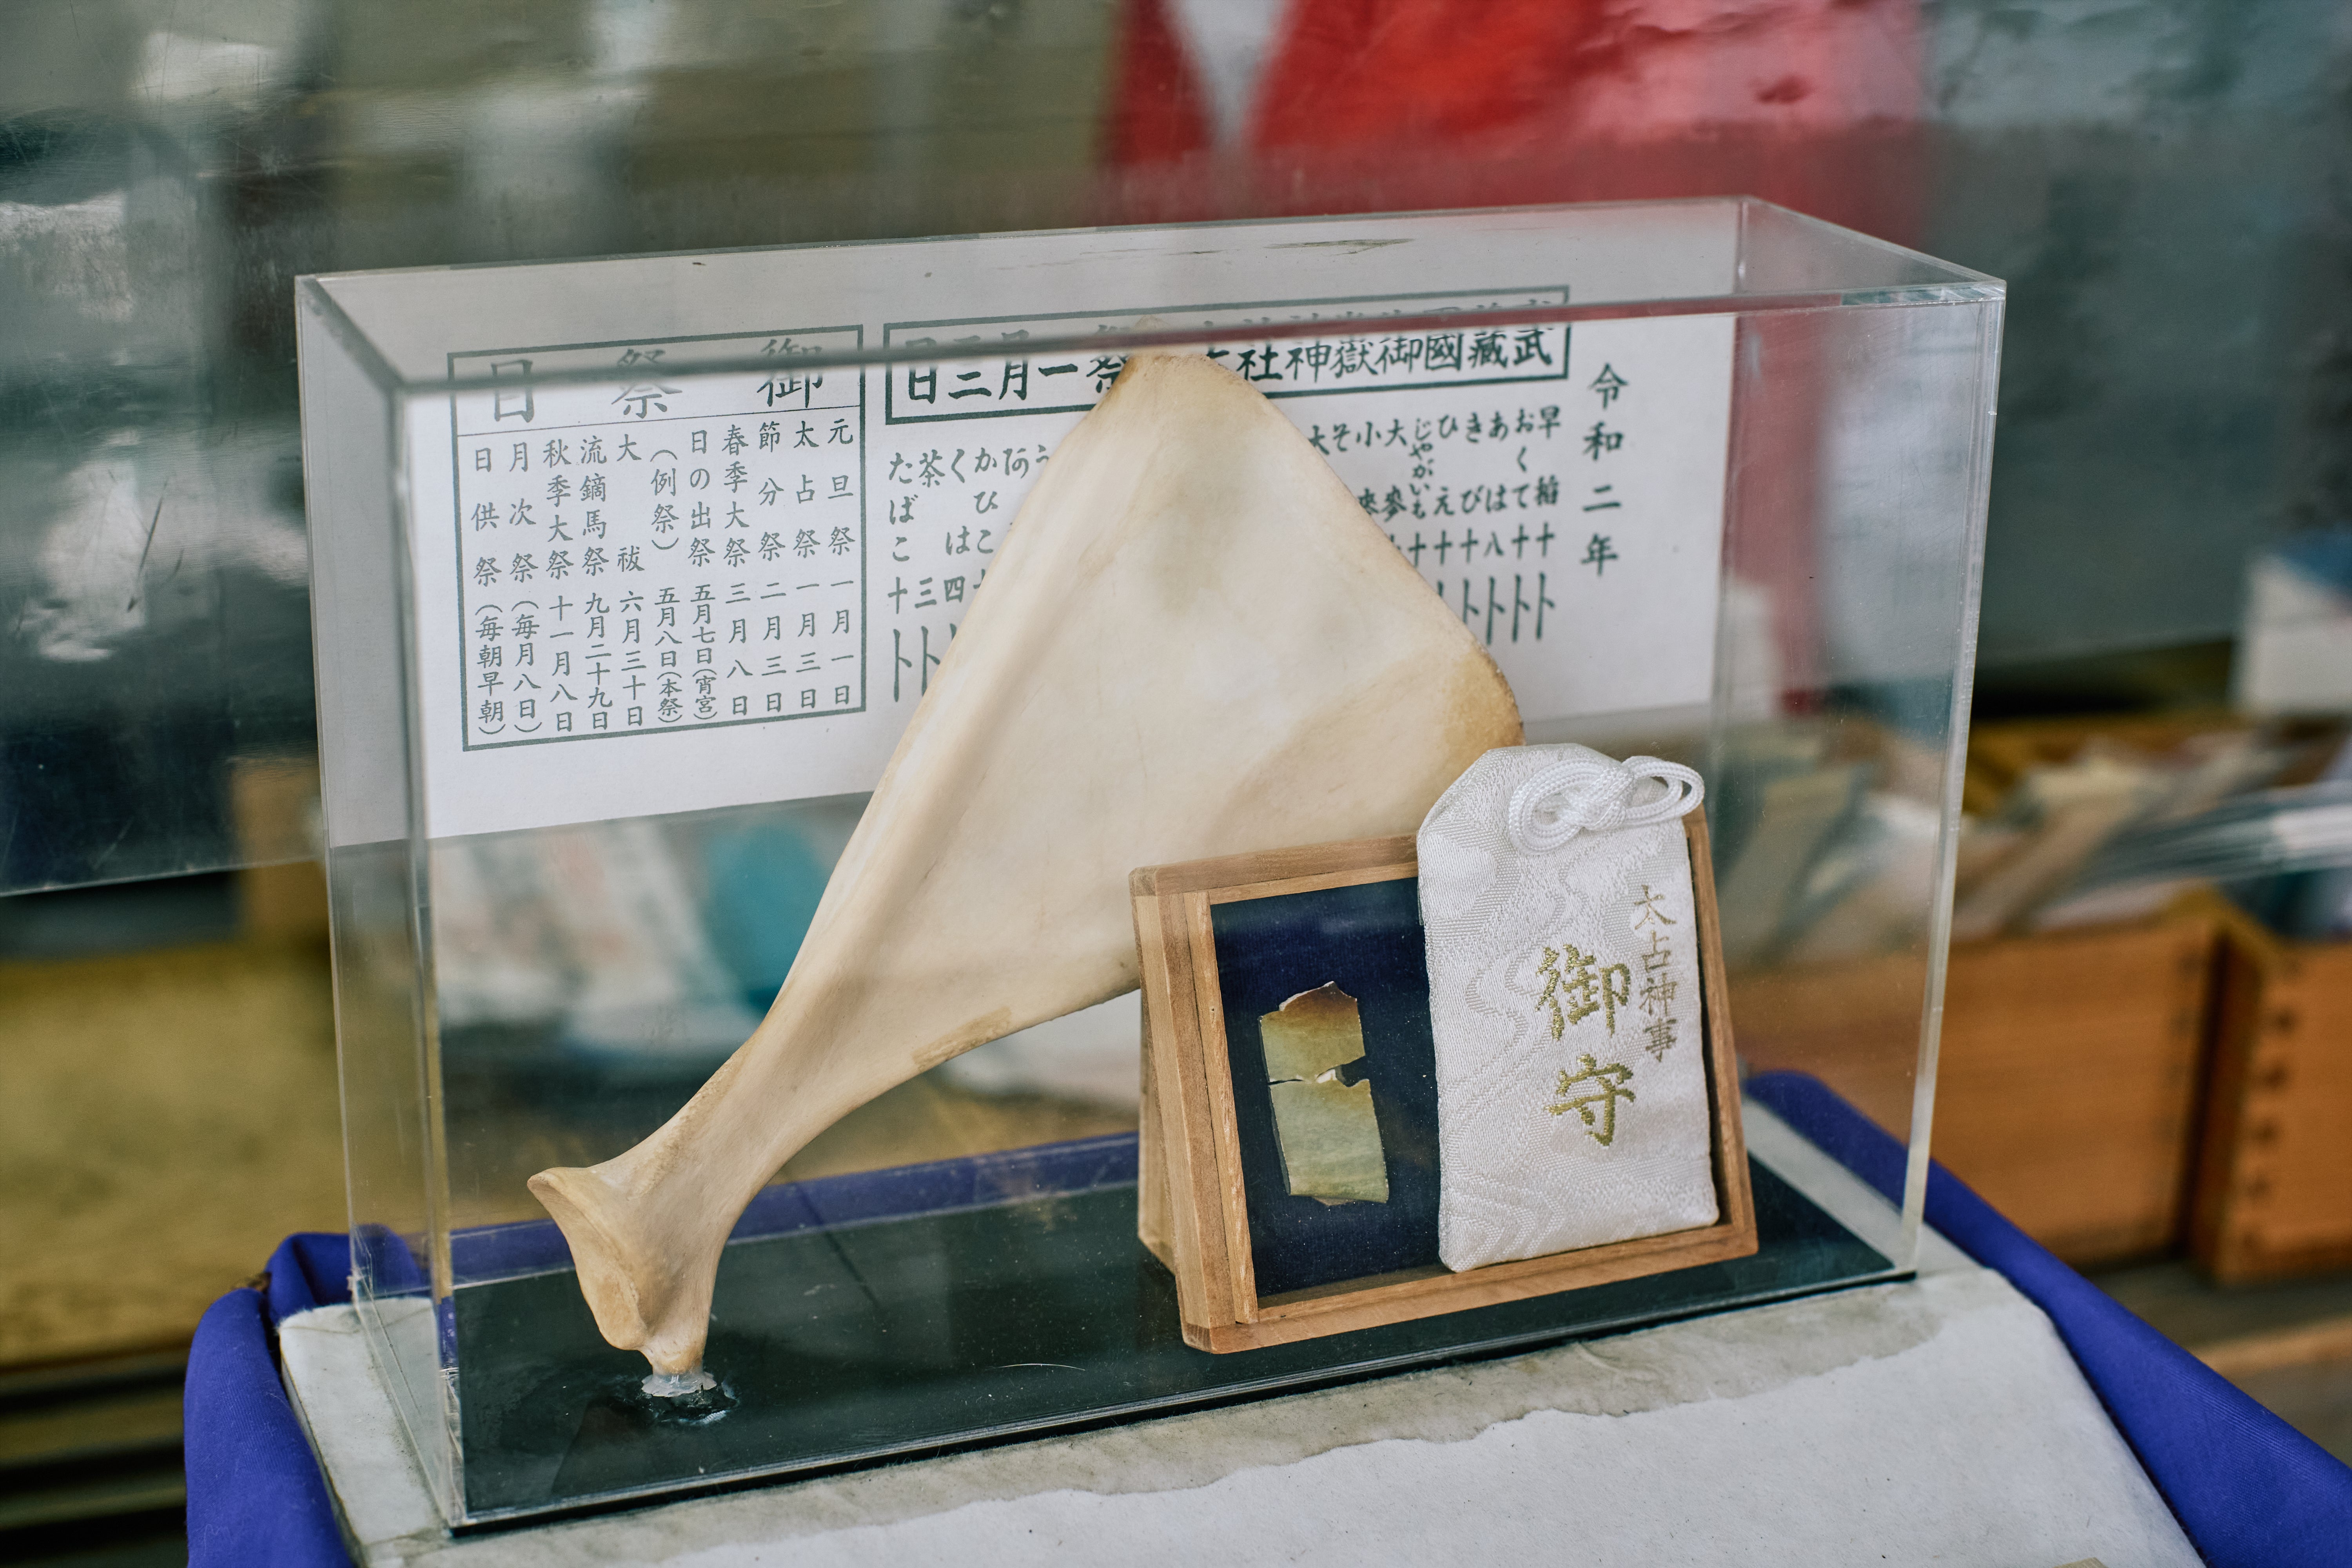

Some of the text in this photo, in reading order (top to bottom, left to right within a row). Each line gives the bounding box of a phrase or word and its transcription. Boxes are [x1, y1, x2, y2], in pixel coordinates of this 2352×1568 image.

[1581, 363, 1629, 576] 令和二年
[1535, 943, 1636, 1147] 御守
[1633, 884, 1678, 1064] 太占神事
